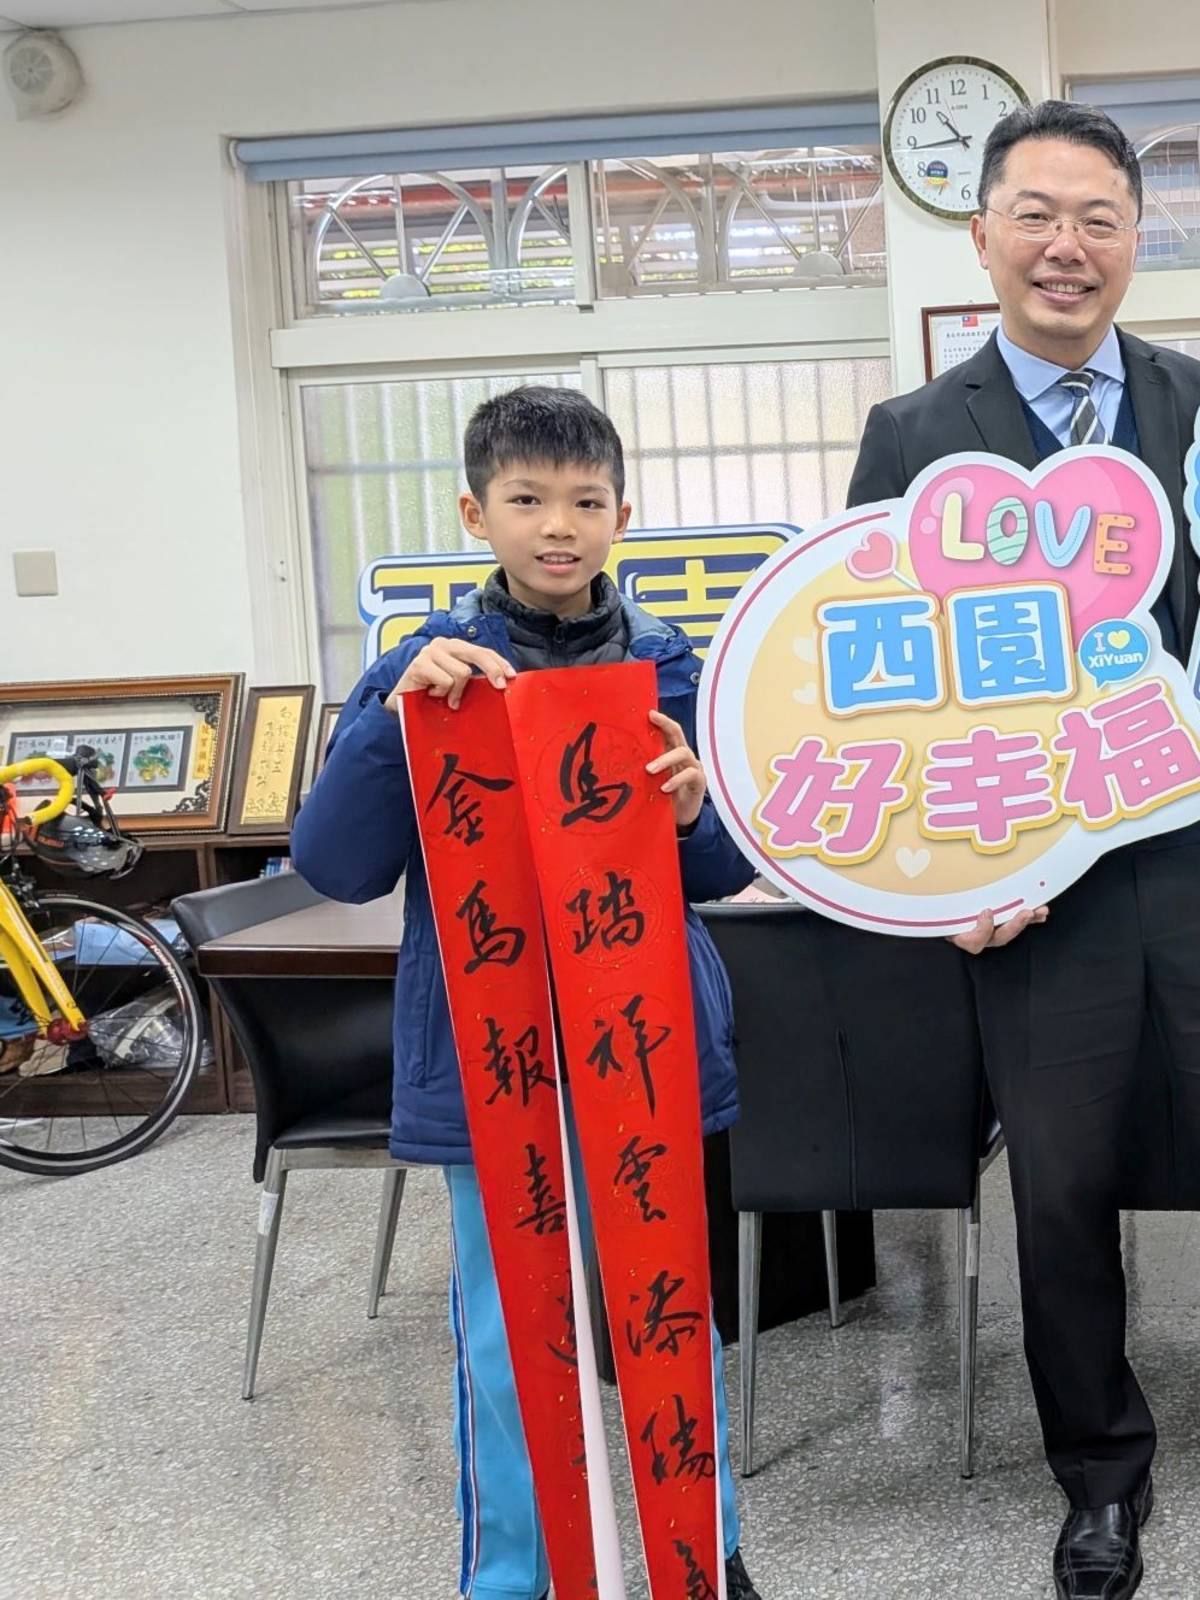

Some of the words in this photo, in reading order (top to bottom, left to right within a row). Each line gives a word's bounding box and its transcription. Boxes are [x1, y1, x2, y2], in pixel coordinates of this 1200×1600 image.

[950, 79, 967, 96] 12
[981, 84, 990, 100] 1
[926, 88, 941, 105] 11
[910, 107, 927, 124] 10
[998, 101, 1008, 118] 2
[907, 136, 918, 151] 9
[917, 161, 928, 179] 8
[961, 184, 972, 201] 6
[940, 492, 1136, 576] LOVE
[822, 588, 1070, 709] 西園
[1094, 632, 1106, 652] I
